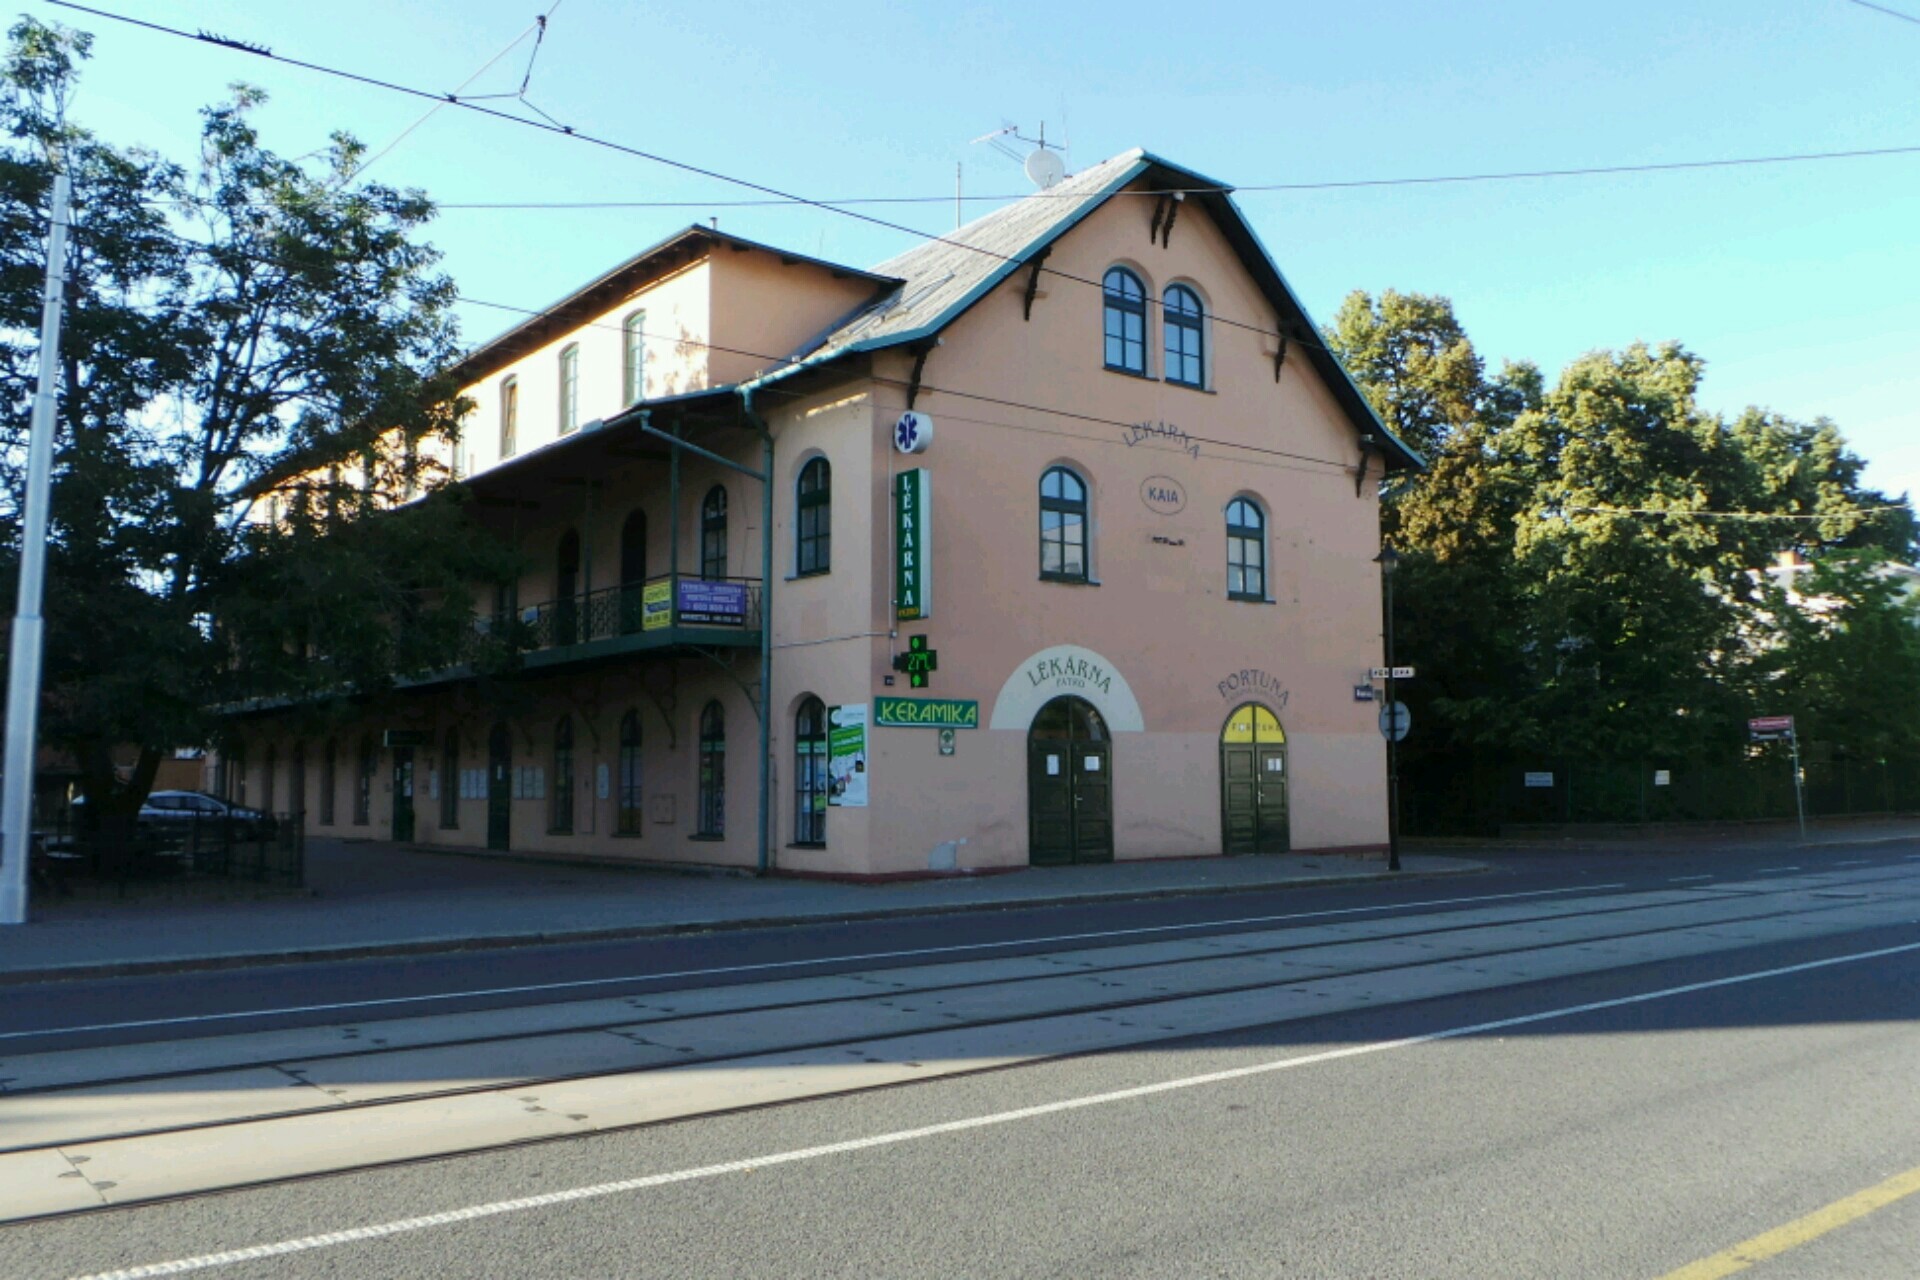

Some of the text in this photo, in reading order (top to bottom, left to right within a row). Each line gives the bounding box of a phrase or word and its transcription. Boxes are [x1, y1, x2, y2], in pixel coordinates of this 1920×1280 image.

[1148, 486, 1178, 504] KAIA
[1217, 669, 1289, 706] FORTUNA
[882, 702, 977, 722] KERAMIKA
